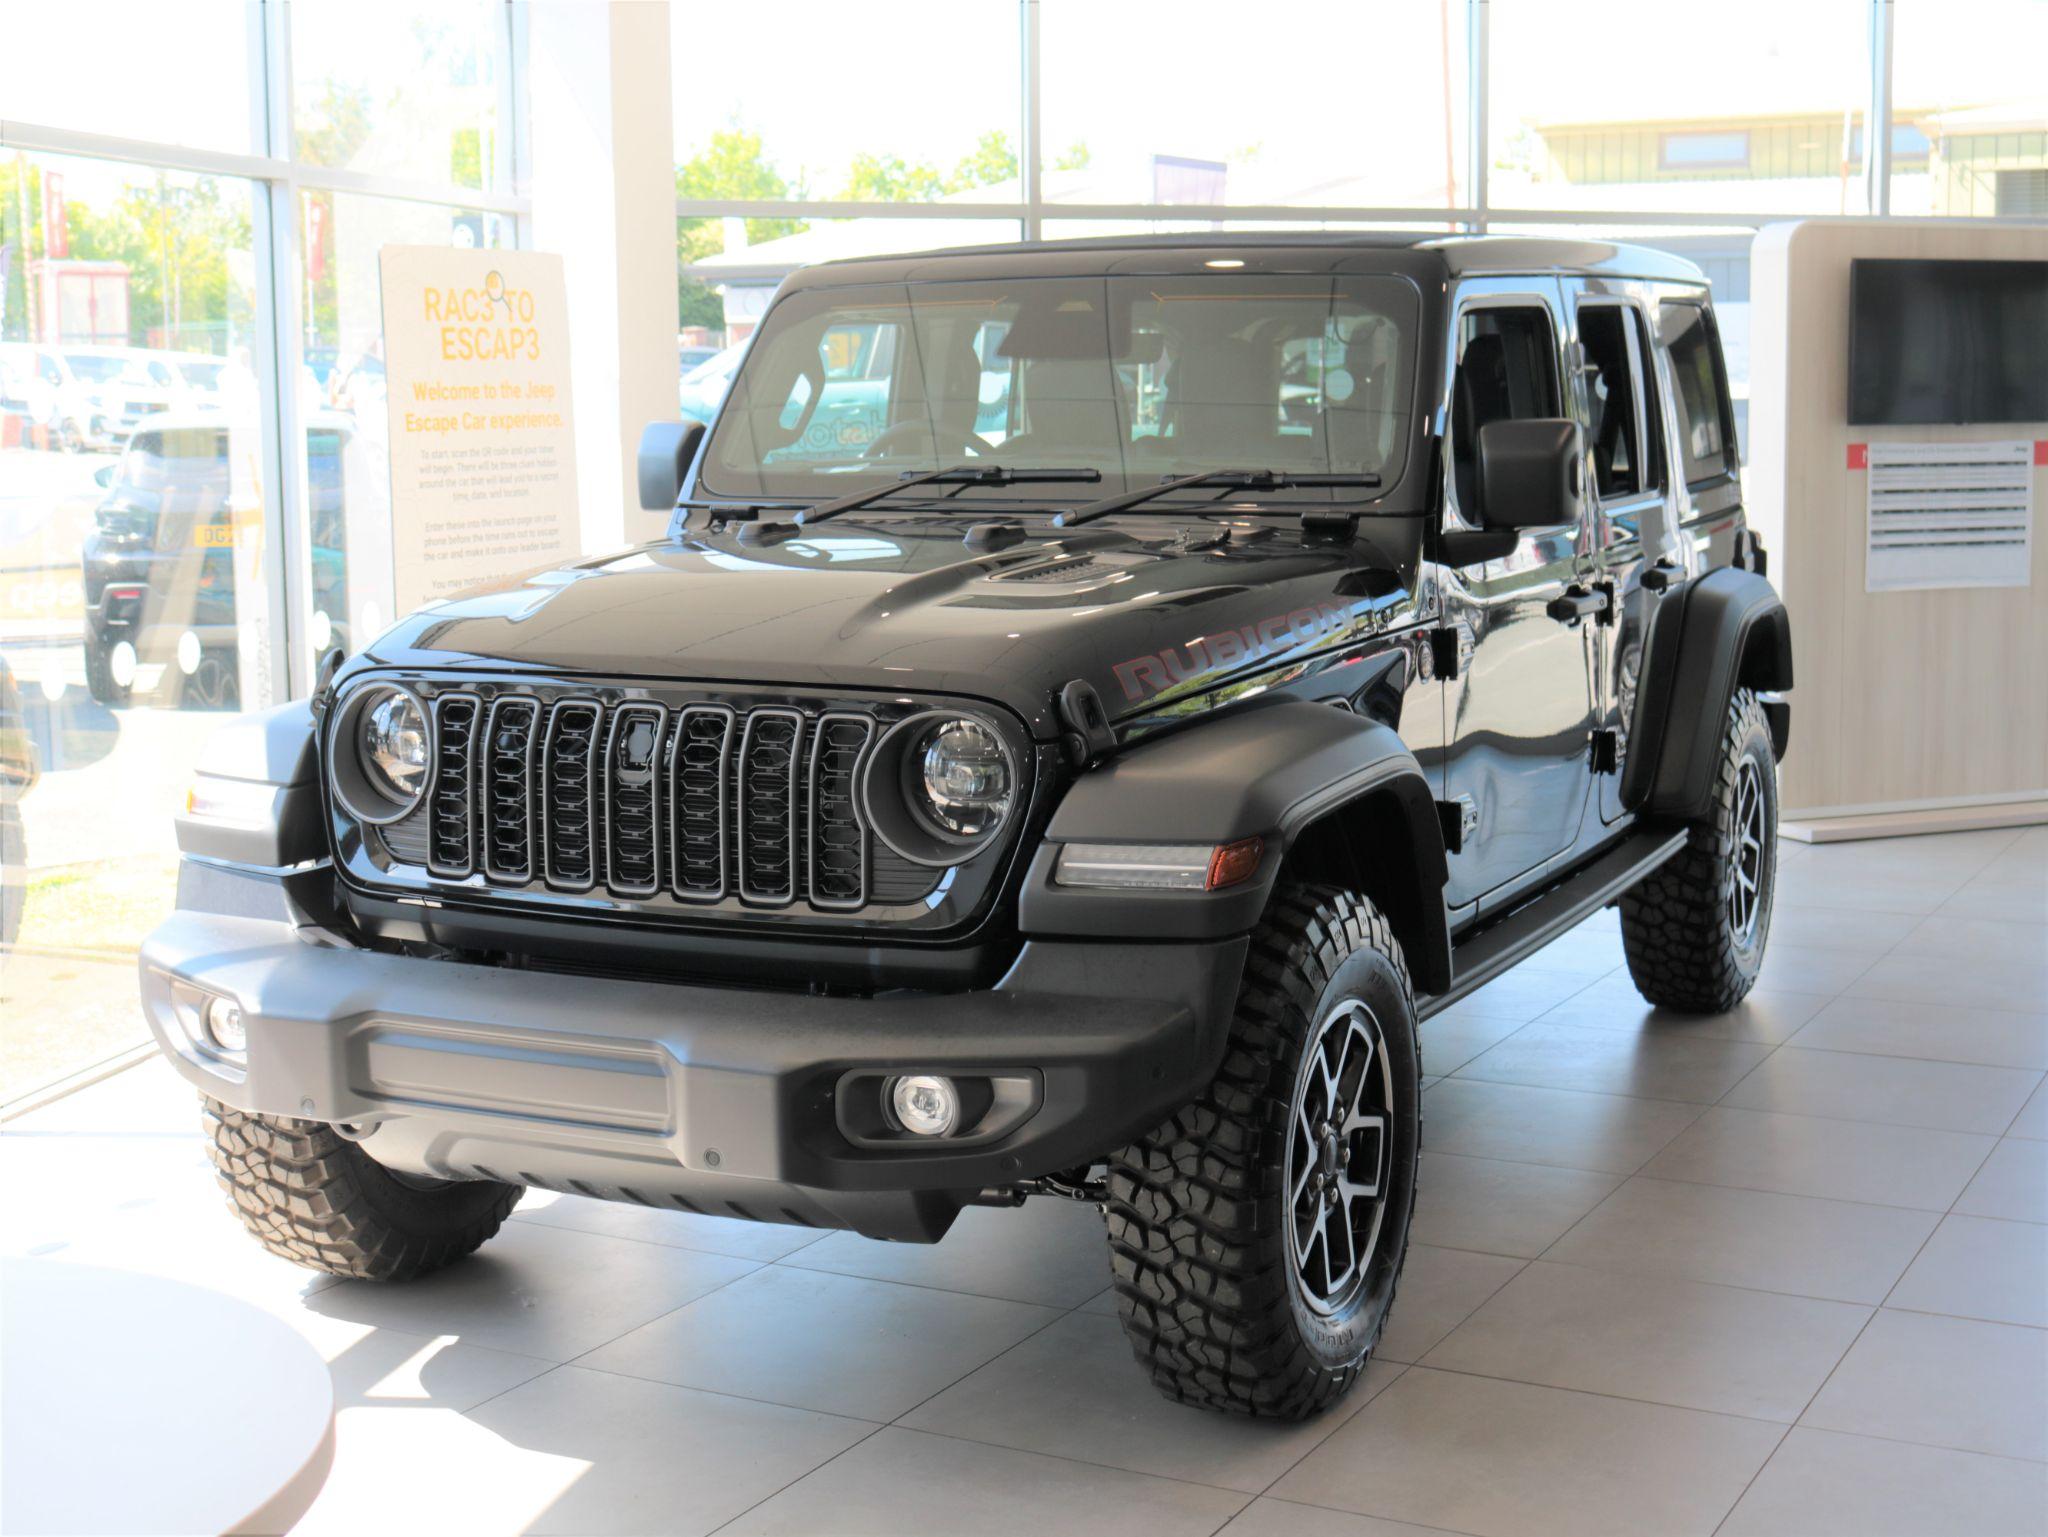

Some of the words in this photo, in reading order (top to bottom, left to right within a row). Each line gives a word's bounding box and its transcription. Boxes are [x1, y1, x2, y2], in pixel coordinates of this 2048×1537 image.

[424, 287, 495, 322] RAC3
[503, 289, 535, 323] TO
[441, 326, 541, 361] ESCAP3
[412, 380, 480, 401] Welcome
[483, 383, 496, 400] to
[499, 380, 521, 400] the
[525, 379, 556, 404] Jeep
[405, 411, 458, 437] Escape
[462, 411, 487, 432] Car
[490, 411, 564, 434] experience.
[1112, 597, 1355, 700] RUBICON
